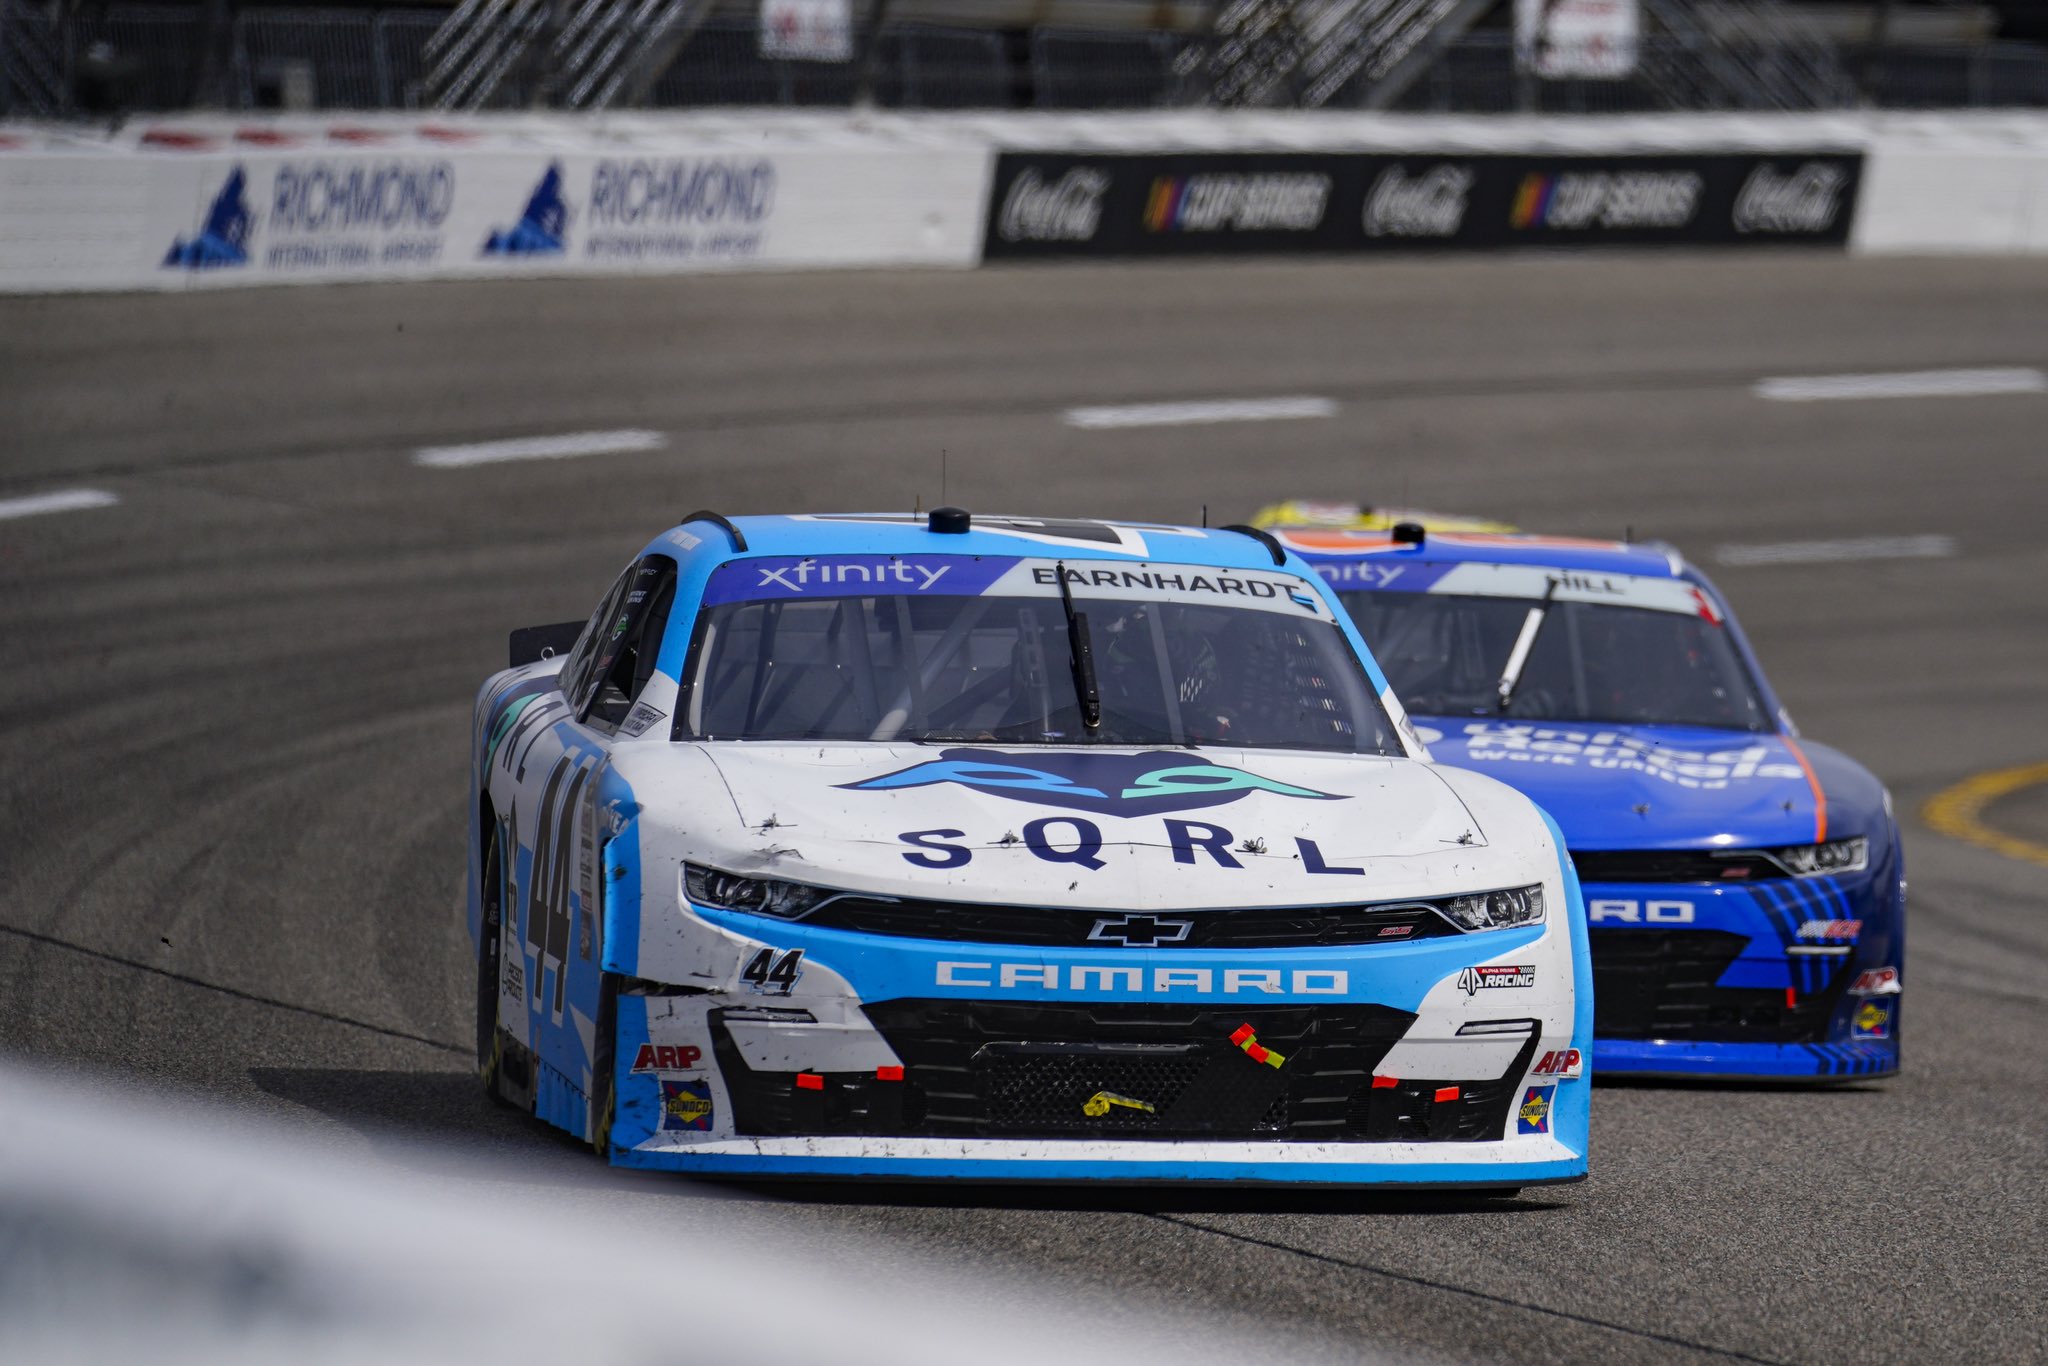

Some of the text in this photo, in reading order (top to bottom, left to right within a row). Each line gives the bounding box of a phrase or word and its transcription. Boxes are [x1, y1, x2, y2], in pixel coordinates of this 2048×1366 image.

[271, 158, 455, 232] RICHMOND
[588, 156, 778, 226] RICHMOND
[757, 559, 952, 592] xfinity
[1032, 567, 1300, 600] EARNHARDT
[1469, 749, 1577, 767] Work
[897, 816, 1366, 876] SQRL
[526, 752, 590, 1015] 44
[741, 947, 805, 992] 44
[935, 960, 1349, 995] CAMARO
[1484, 973, 1534, 988] RACING
[633, 1044, 702, 1069] ARP
[668, 1099, 711, 1113] SUNOCO
[1520, 1102, 1549, 1117] SUNOCO
